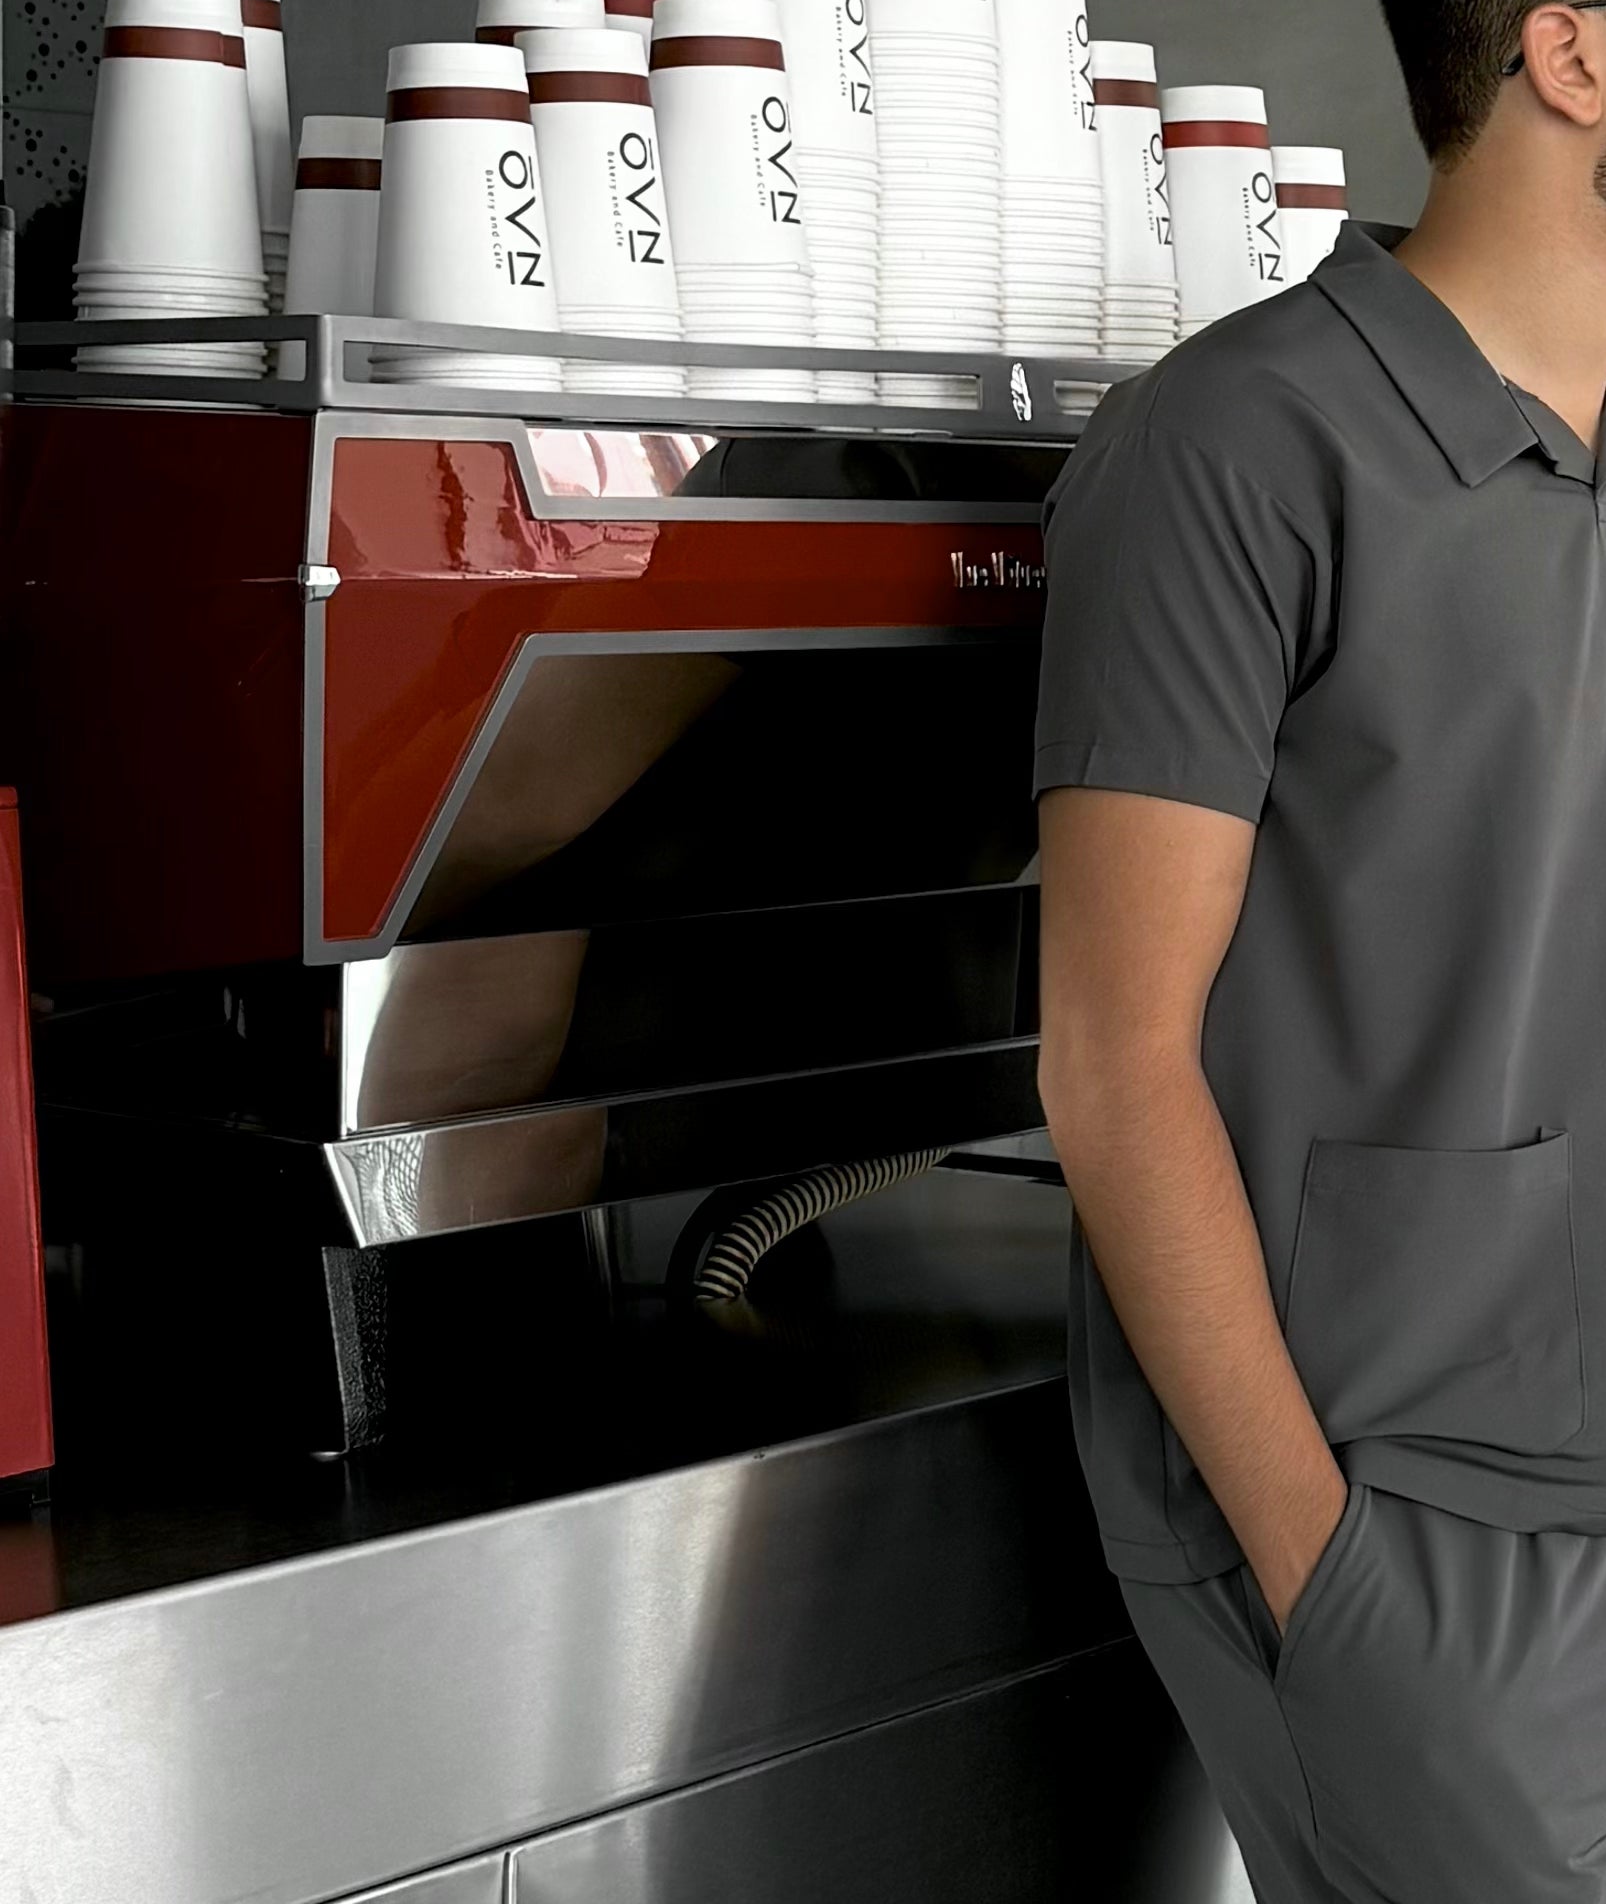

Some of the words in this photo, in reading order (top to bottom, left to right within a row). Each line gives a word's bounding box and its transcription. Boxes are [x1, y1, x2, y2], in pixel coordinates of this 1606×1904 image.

[750, 114, 760, 151] Bakery
[755, 158, 763, 177] and
[485, 170, 496, 209] Bakery
[607, 151, 616, 190] Bakery
[612, 196, 621, 216] and
[490, 216, 499, 237] and
[494, 243, 502, 269] Cafe
